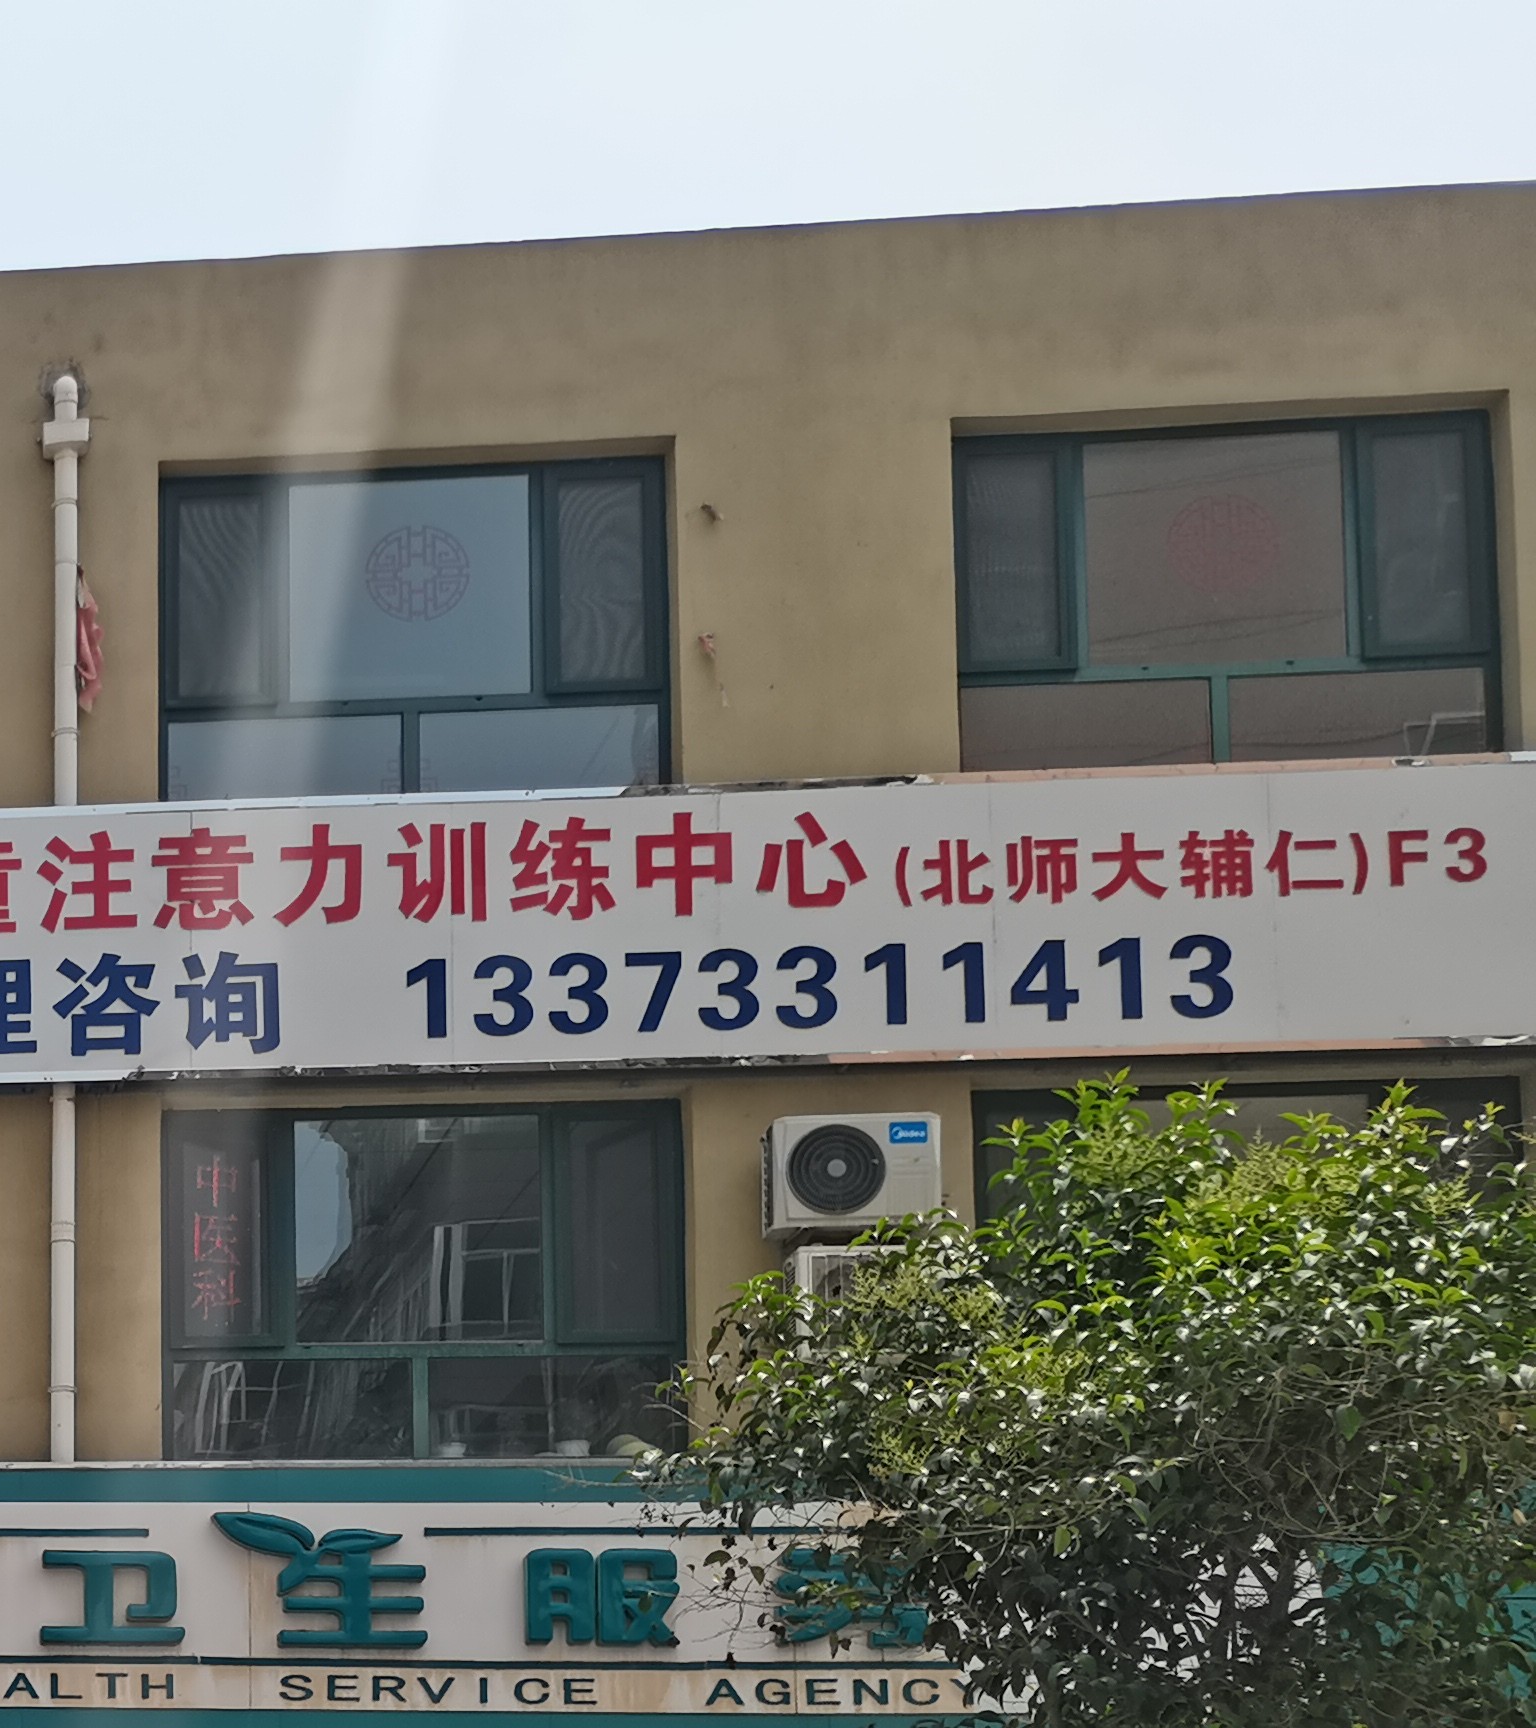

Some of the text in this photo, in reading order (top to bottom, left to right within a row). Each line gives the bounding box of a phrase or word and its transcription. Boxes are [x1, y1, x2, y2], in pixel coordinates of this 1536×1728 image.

[404, 934, 1237, 1039] 13373311413
[278, 1673, 598, 1704] SERVICE
[705, 1676, 977, 1707] AGENCY
